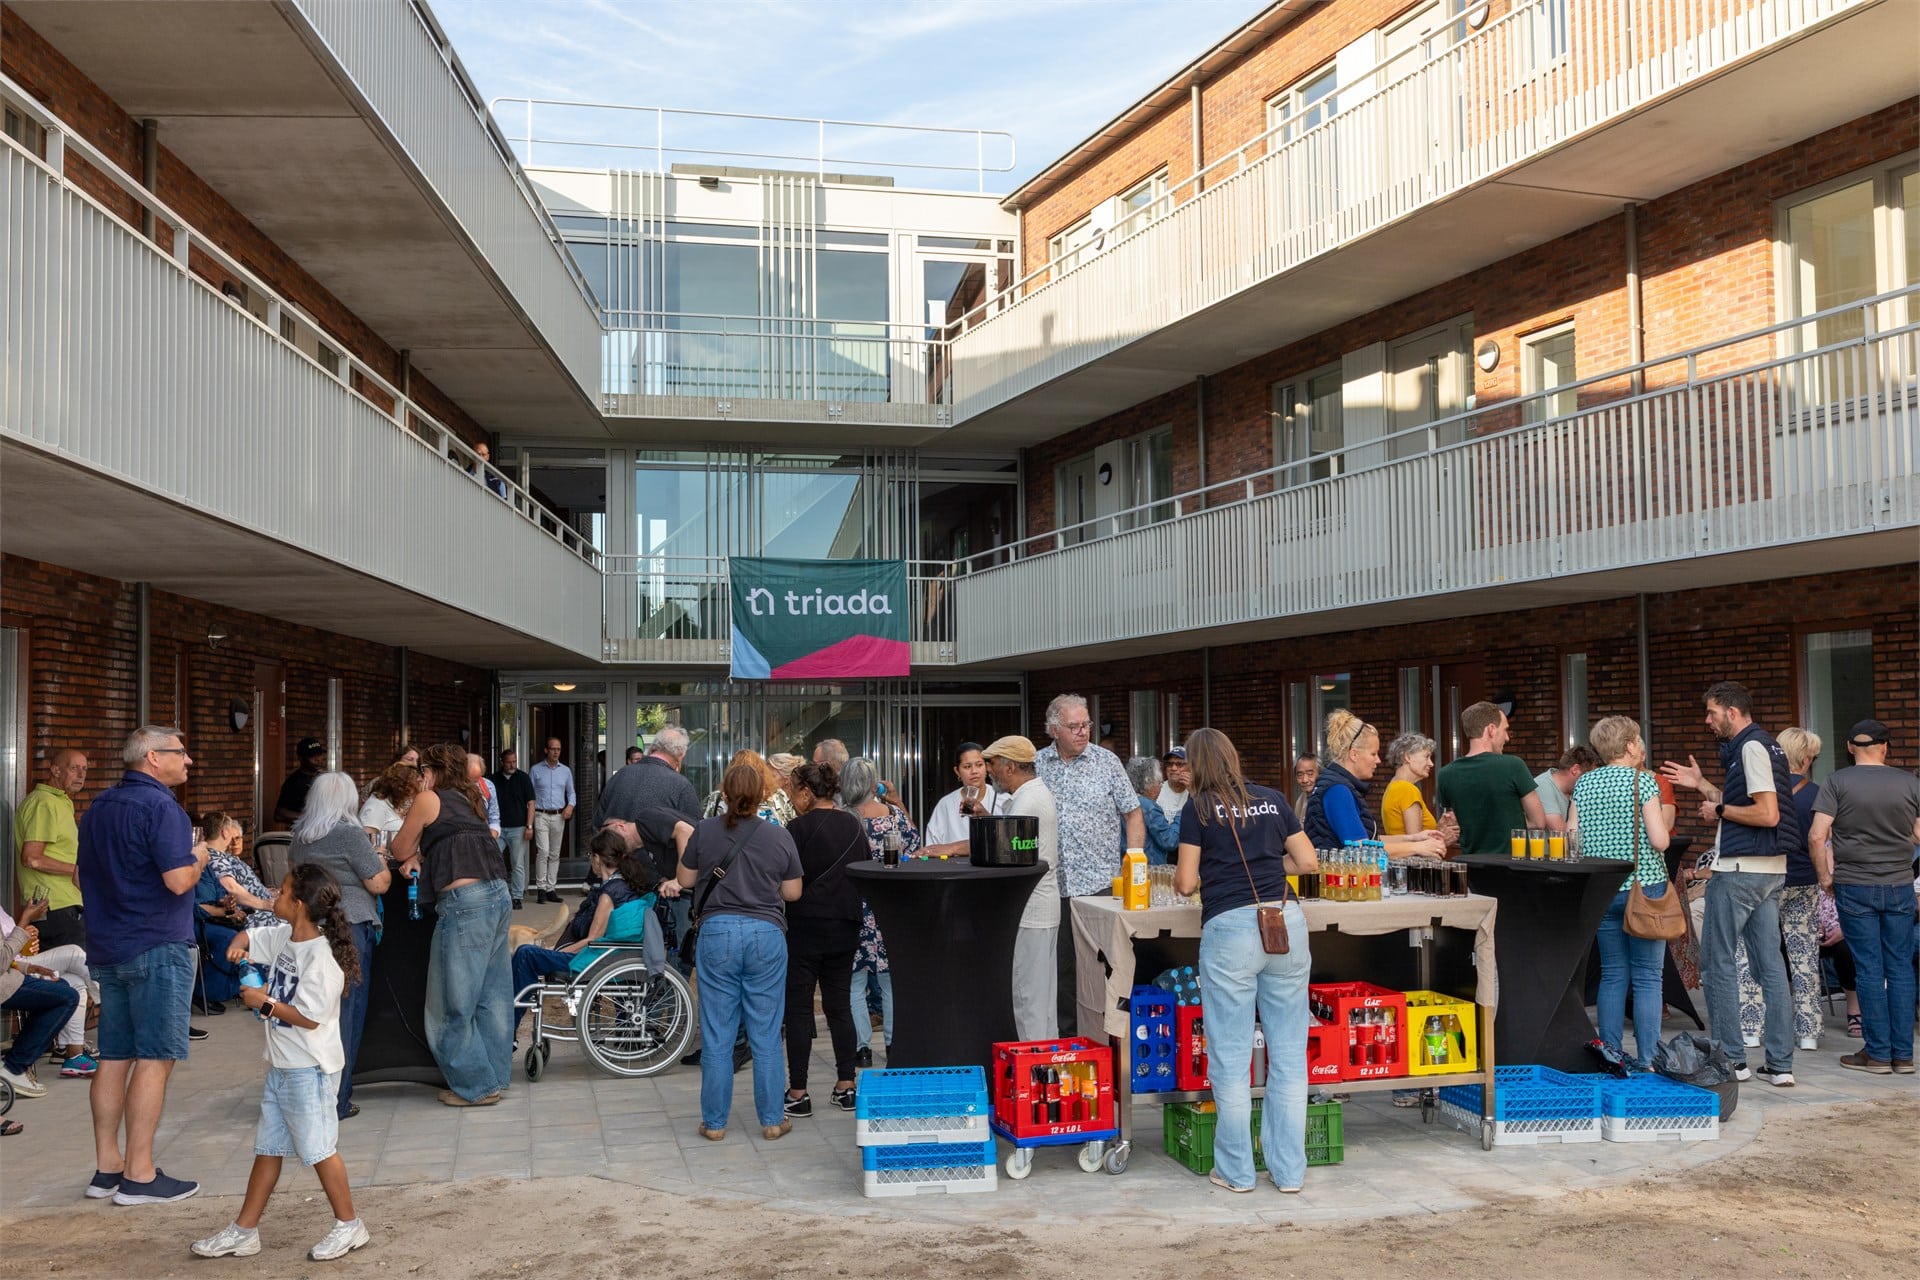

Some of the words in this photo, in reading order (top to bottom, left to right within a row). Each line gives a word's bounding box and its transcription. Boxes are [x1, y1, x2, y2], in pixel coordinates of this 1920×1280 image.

[784, 587, 892, 615] triada
[1231, 801, 1279, 818] tiada
[1360, 1068, 1368, 1076] 12
[1051, 1127, 1058, 1135] 12
